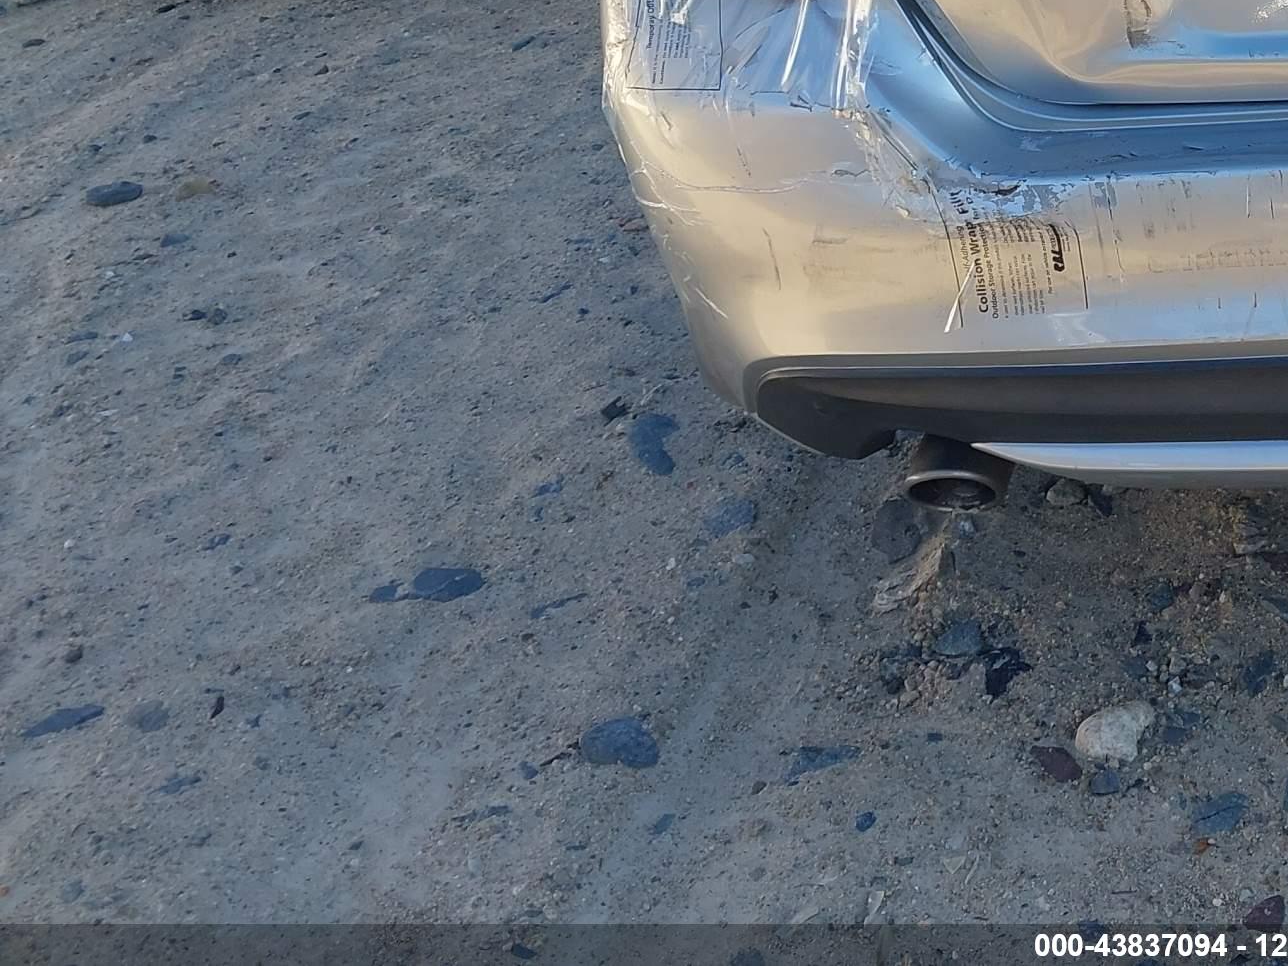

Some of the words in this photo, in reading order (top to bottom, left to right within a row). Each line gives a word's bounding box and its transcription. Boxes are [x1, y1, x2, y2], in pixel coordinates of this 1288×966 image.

[974, 257, 989, 313] Collision
[984, 260, 997, 287] Storage
[988, 288, 999, 319] Outdoor
